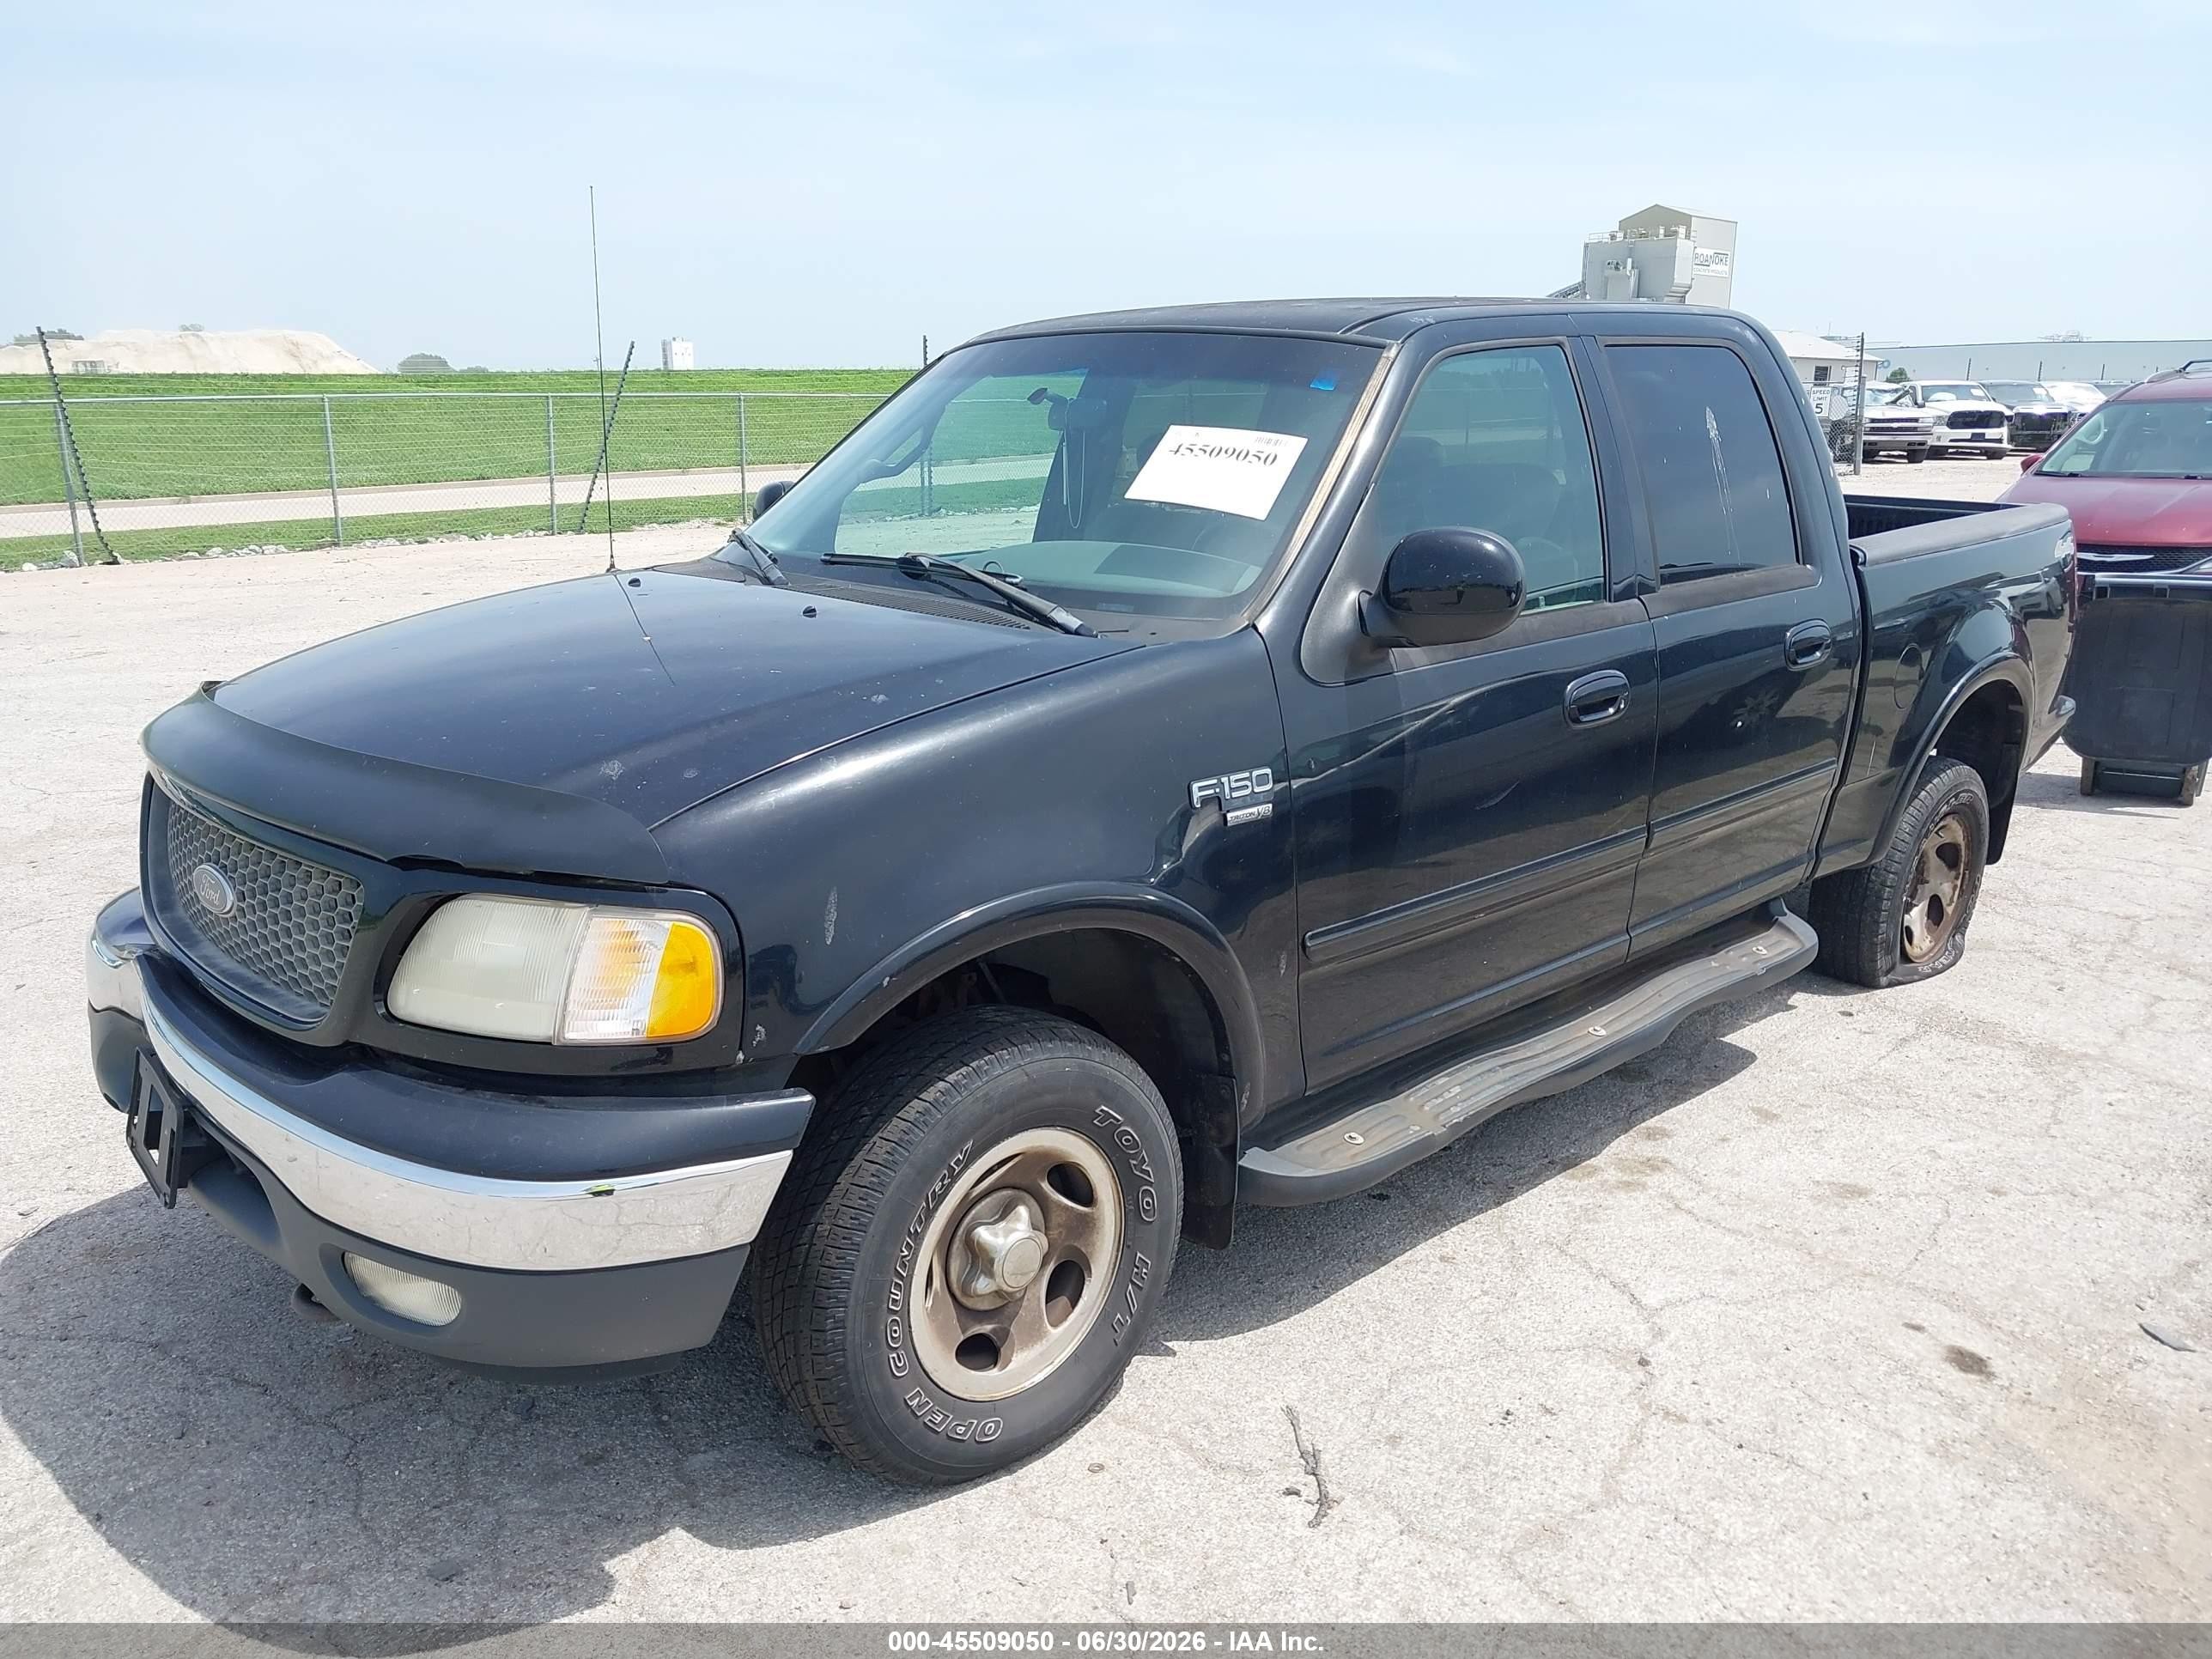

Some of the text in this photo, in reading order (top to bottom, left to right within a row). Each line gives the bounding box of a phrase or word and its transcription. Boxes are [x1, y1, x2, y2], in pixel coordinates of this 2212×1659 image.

[1694, 252, 1729, 266] ROANOKE
[1815, 404, 1823, 414] 5
[1169, 443, 1278, 466] 45509050
[1229, 806, 1271, 822] TRITON V8
[200, 873, 221, 906] Ford
[1092, 1105, 1158, 1223] TOYO
[885, 1139, 974, 1378] COUNTRY
[903, 1387, 1004, 1443] OPEN
